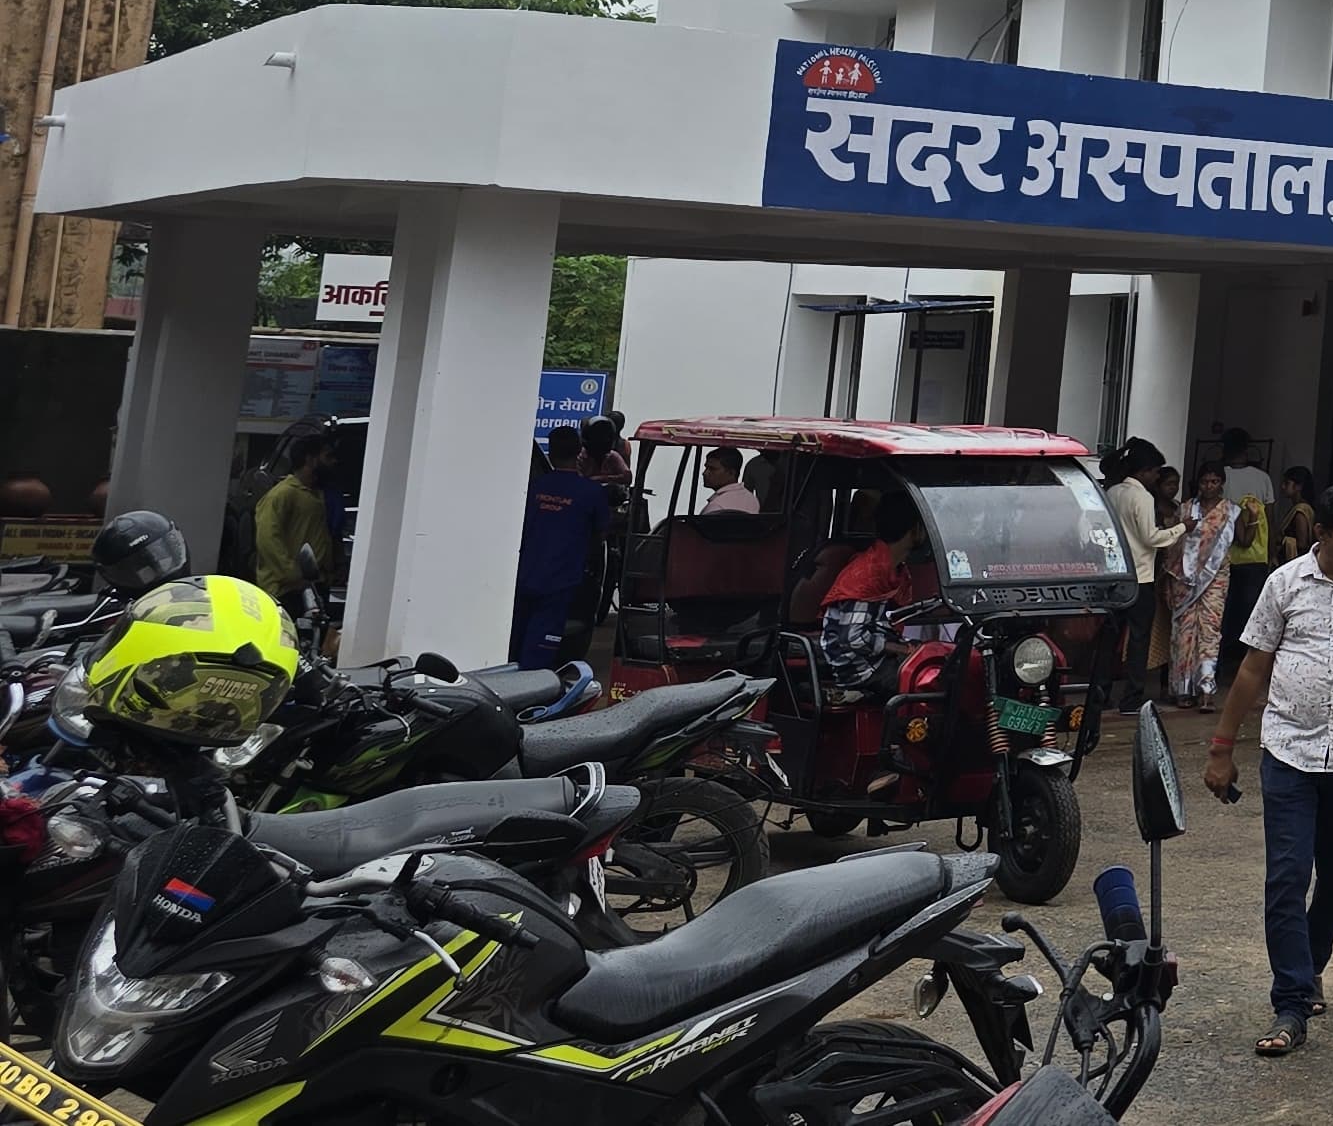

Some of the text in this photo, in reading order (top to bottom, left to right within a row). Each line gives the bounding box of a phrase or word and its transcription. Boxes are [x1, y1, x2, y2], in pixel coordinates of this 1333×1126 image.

[805, 96, 1014, 203] सदर
[559, 398, 597, 412] सेवाएँ
[1012, 586, 1081, 603] DELTIC
[200, 676, 258, 700] STUDDS
[152, 894, 202, 923] HONDA
[650, 1013, 759, 1075] HORNET
[211, 1057, 289, 1084] HONDA
